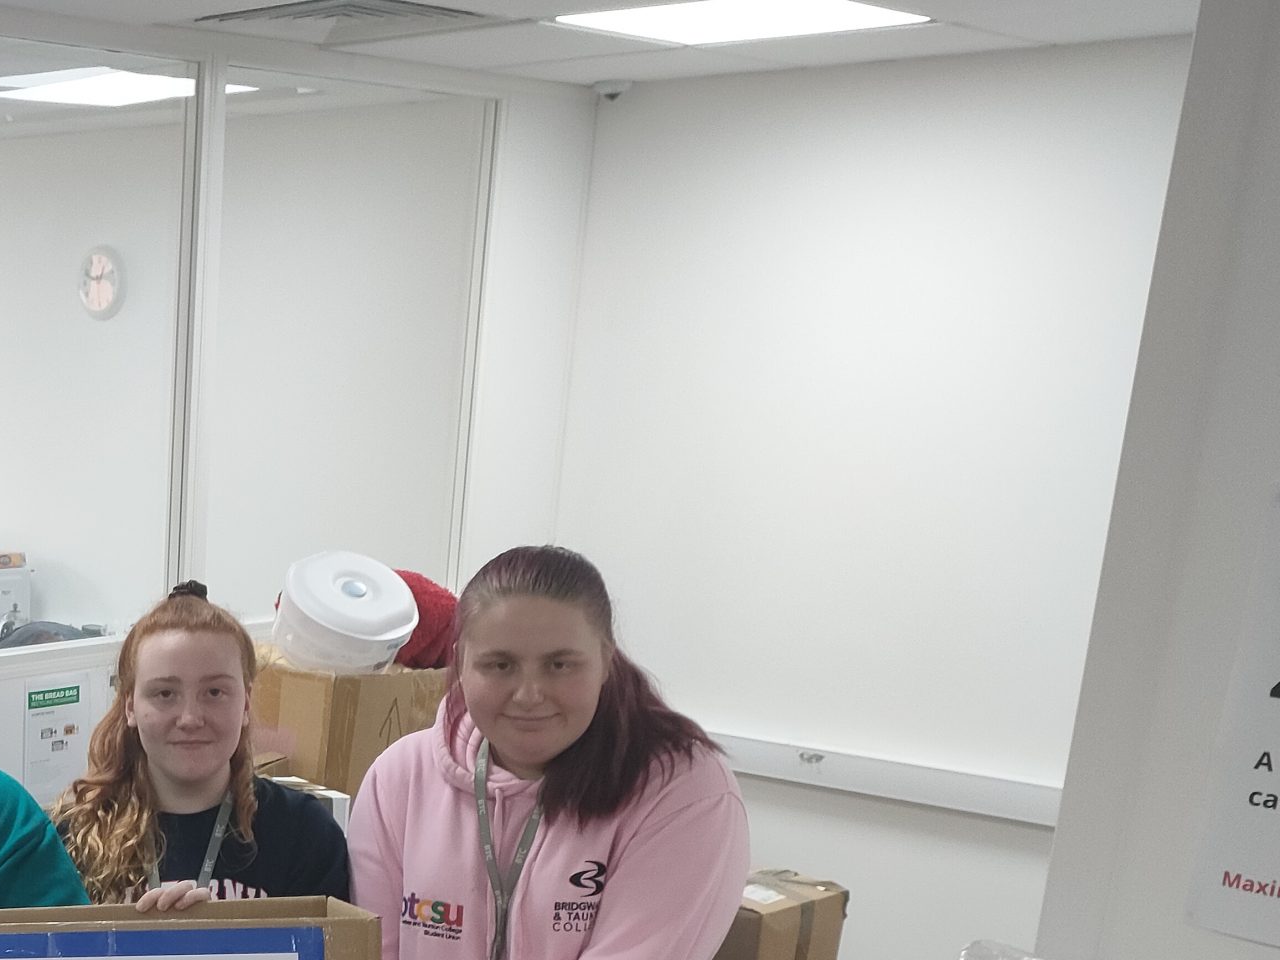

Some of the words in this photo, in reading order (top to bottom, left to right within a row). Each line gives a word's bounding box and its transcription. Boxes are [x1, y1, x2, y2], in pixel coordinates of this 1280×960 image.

[31, 694, 44, 702] THE
[45, 691, 64, 700] BREAD
[65, 688, 78, 697] BAG
[1254, 751, 1274, 772] A
[1222, 870, 1280, 898] Maxi
[553, 912, 562, 921] &
